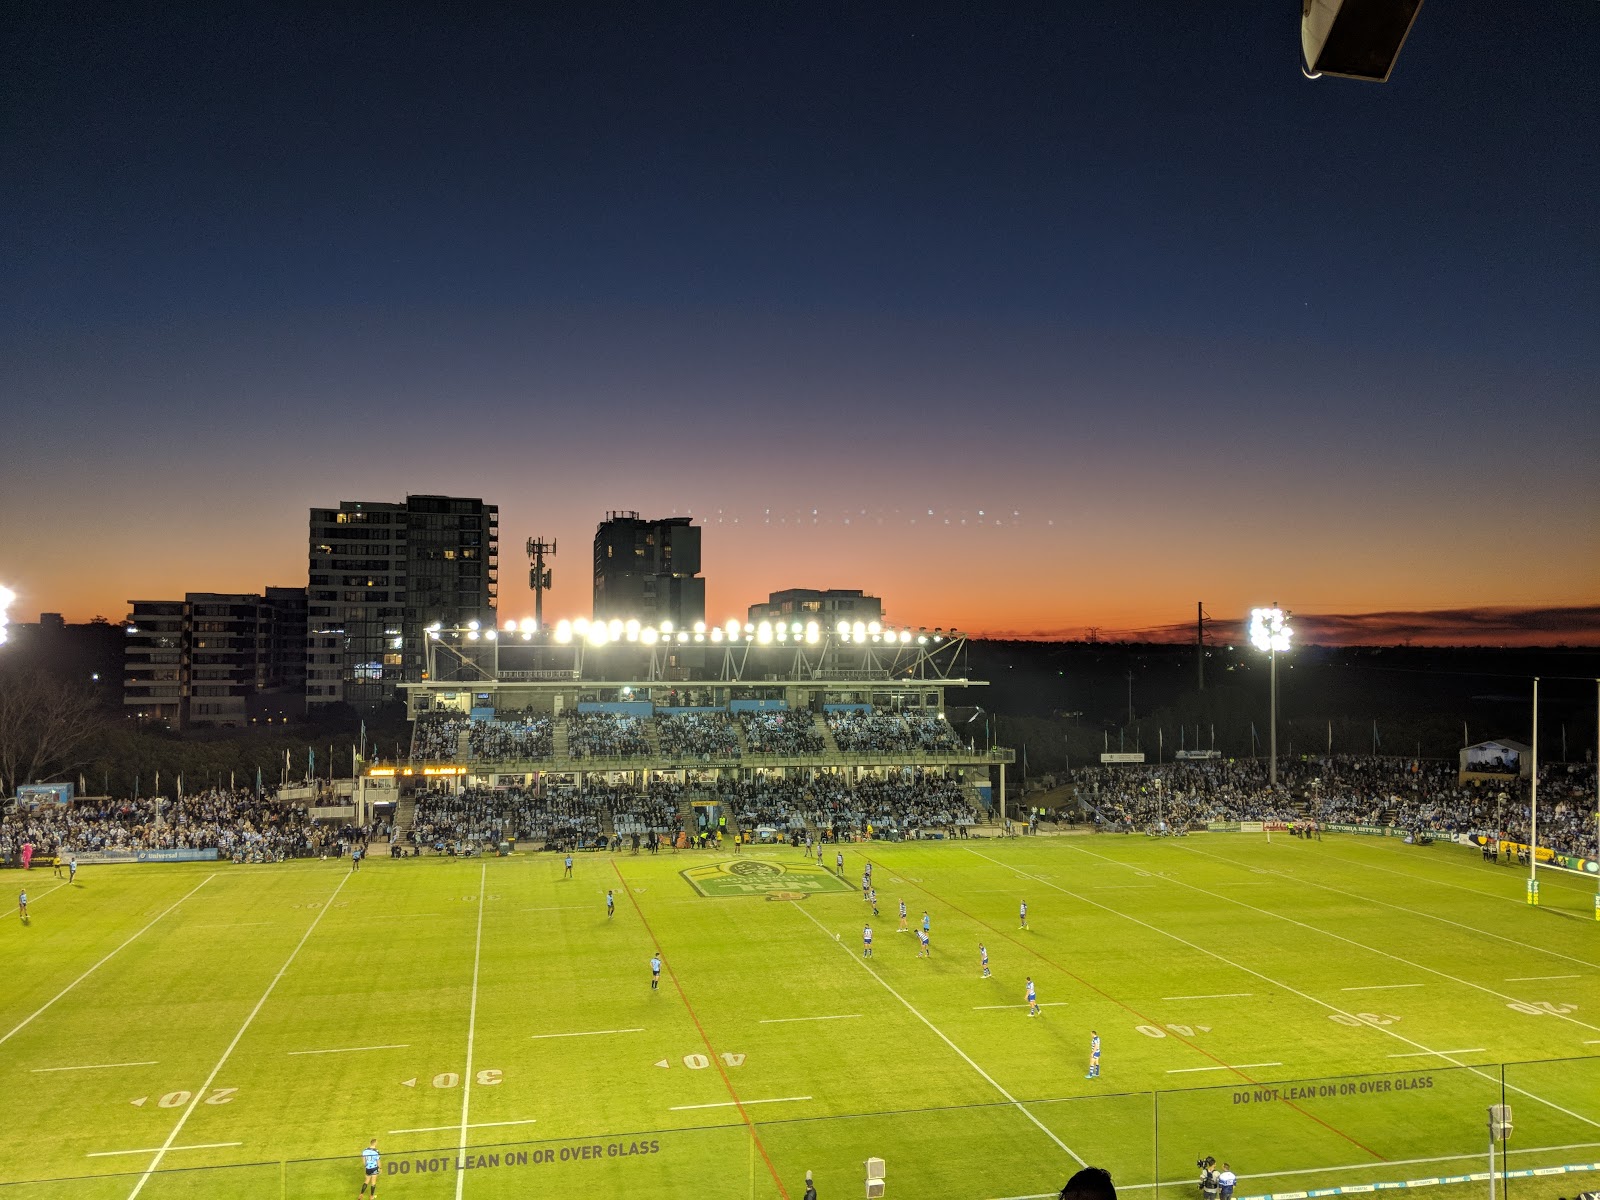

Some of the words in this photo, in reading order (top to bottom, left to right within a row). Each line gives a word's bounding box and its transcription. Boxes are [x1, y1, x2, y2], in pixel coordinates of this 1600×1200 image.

[1327, 824, 1357, 832] VICTORIA
[1358, 826, 1382, 834] BITTER
[682, 1052, 747, 1070] 40
[432, 1069, 504, 1088] 30
[157, 1087, 239, 1108] 20
[1233, 1091, 1250, 1104] DO
[1253, 1089, 1279, 1103] NOT
[1283, 1086, 1316, 1100] LEAN
[1319, 1085, 1337, 1097] ON
[1340, 1083, 1356, 1096] OR
[1359, 1080, 1392, 1094] OVER
[1394, 1077, 1433, 1091] GLASS
[387, 1161, 410, 1176] DO
[415, 1157, 450, 1174] NOT
[455, 1153, 500, 1170] LEAN
[504, 1151, 528, 1166] ON
[532, 1149, 555, 1164] OR
[559, 1145, 603, 1162] OVER
[607, 1140, 660, 1158] GLASS
